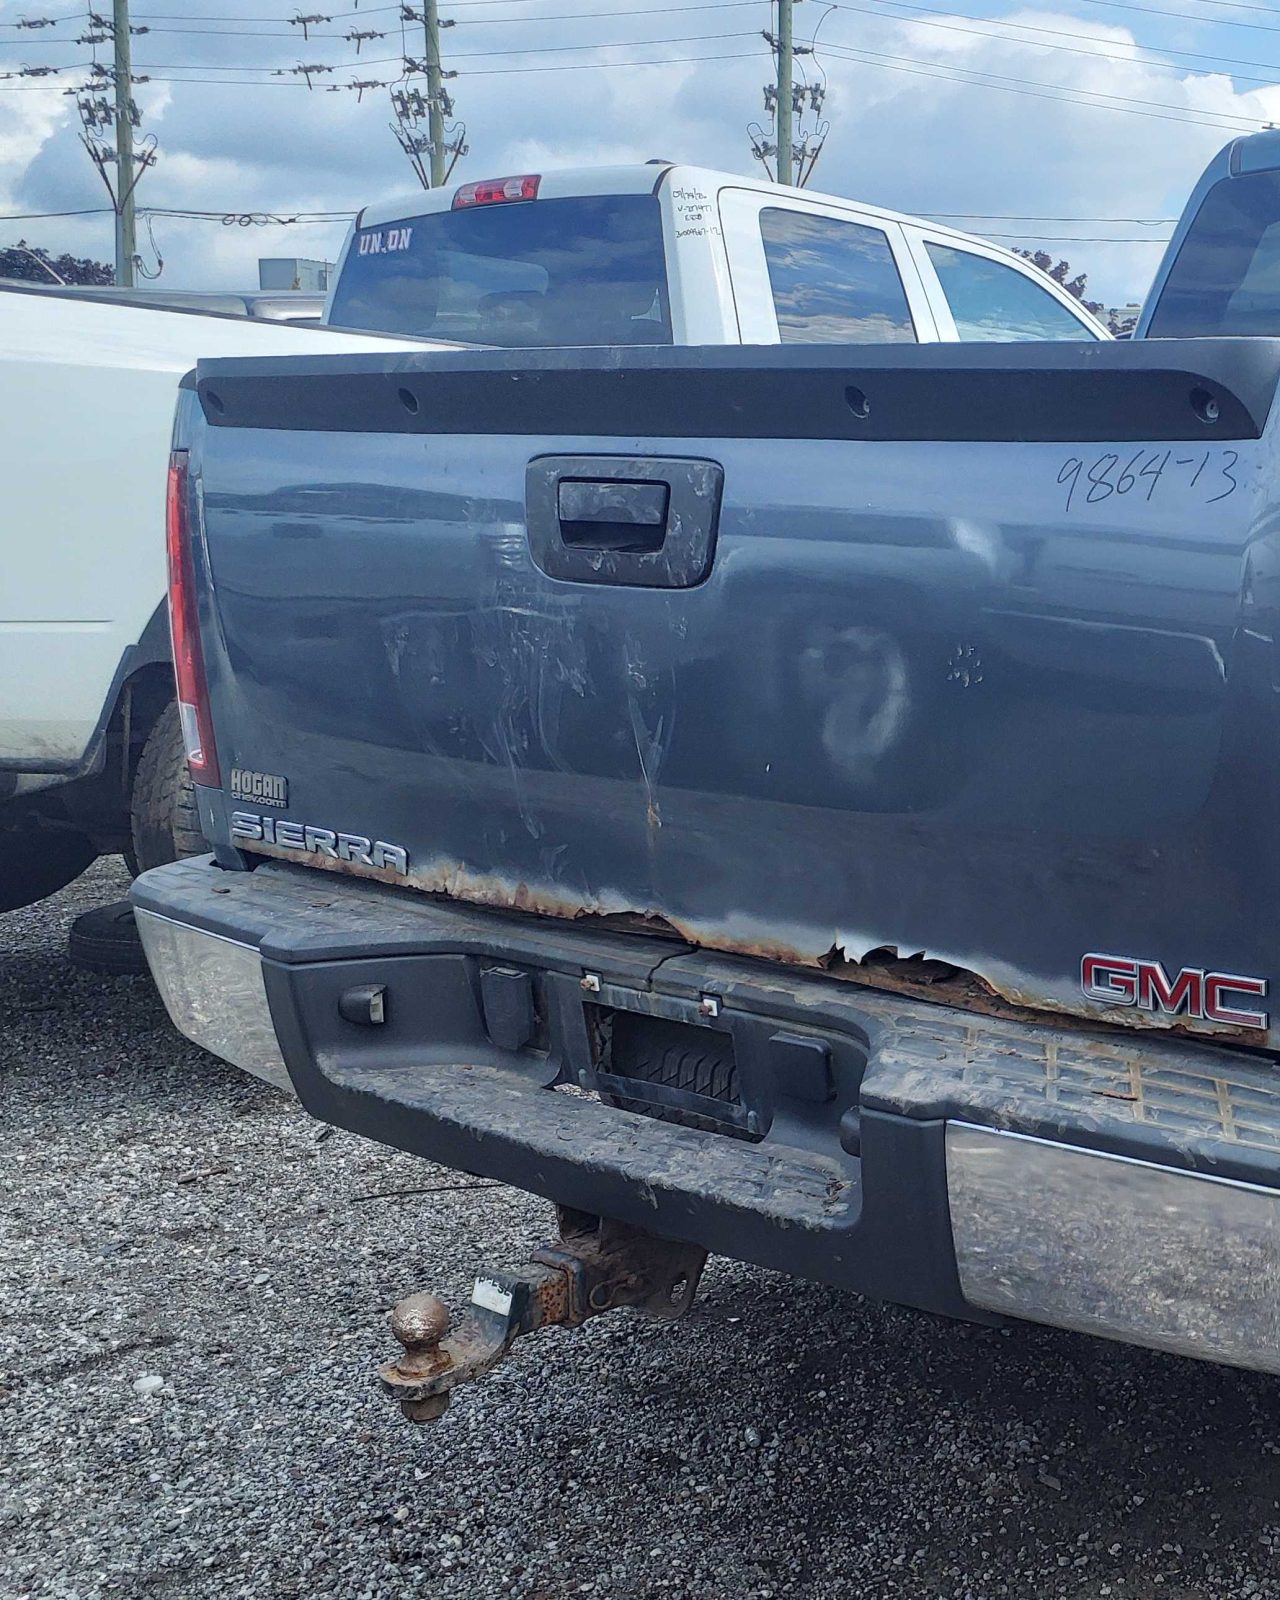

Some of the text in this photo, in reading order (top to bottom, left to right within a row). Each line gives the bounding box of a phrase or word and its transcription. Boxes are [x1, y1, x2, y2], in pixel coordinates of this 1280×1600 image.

[359, 226, 413, 256] UNON
[1057, 449, 1239, 513] 9864-13
[231, 768, 287, 801] HOGAN
[231, 791, 287, 809] chev.com
[232, 811, 408, 876] SIERRA
[1080, 952, 1269, 1030] GMC
